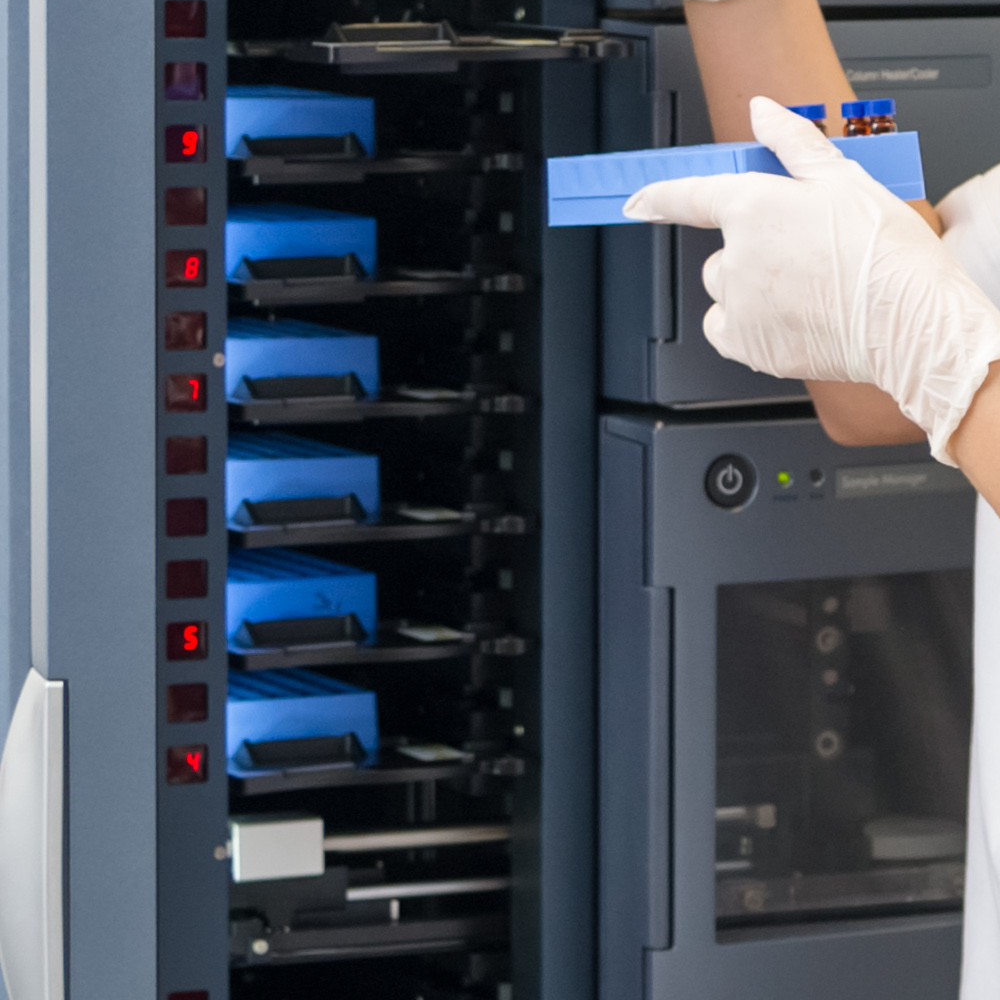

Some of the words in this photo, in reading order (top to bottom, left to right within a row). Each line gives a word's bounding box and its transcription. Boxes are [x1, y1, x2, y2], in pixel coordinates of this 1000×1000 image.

[182, 131, 198, 156] 9
[184, 256, 199, 279] 8
[188, 379, 200, 400] 7
[183, 625, 198, 651] 5
[186, 752, 201, 772] 4
